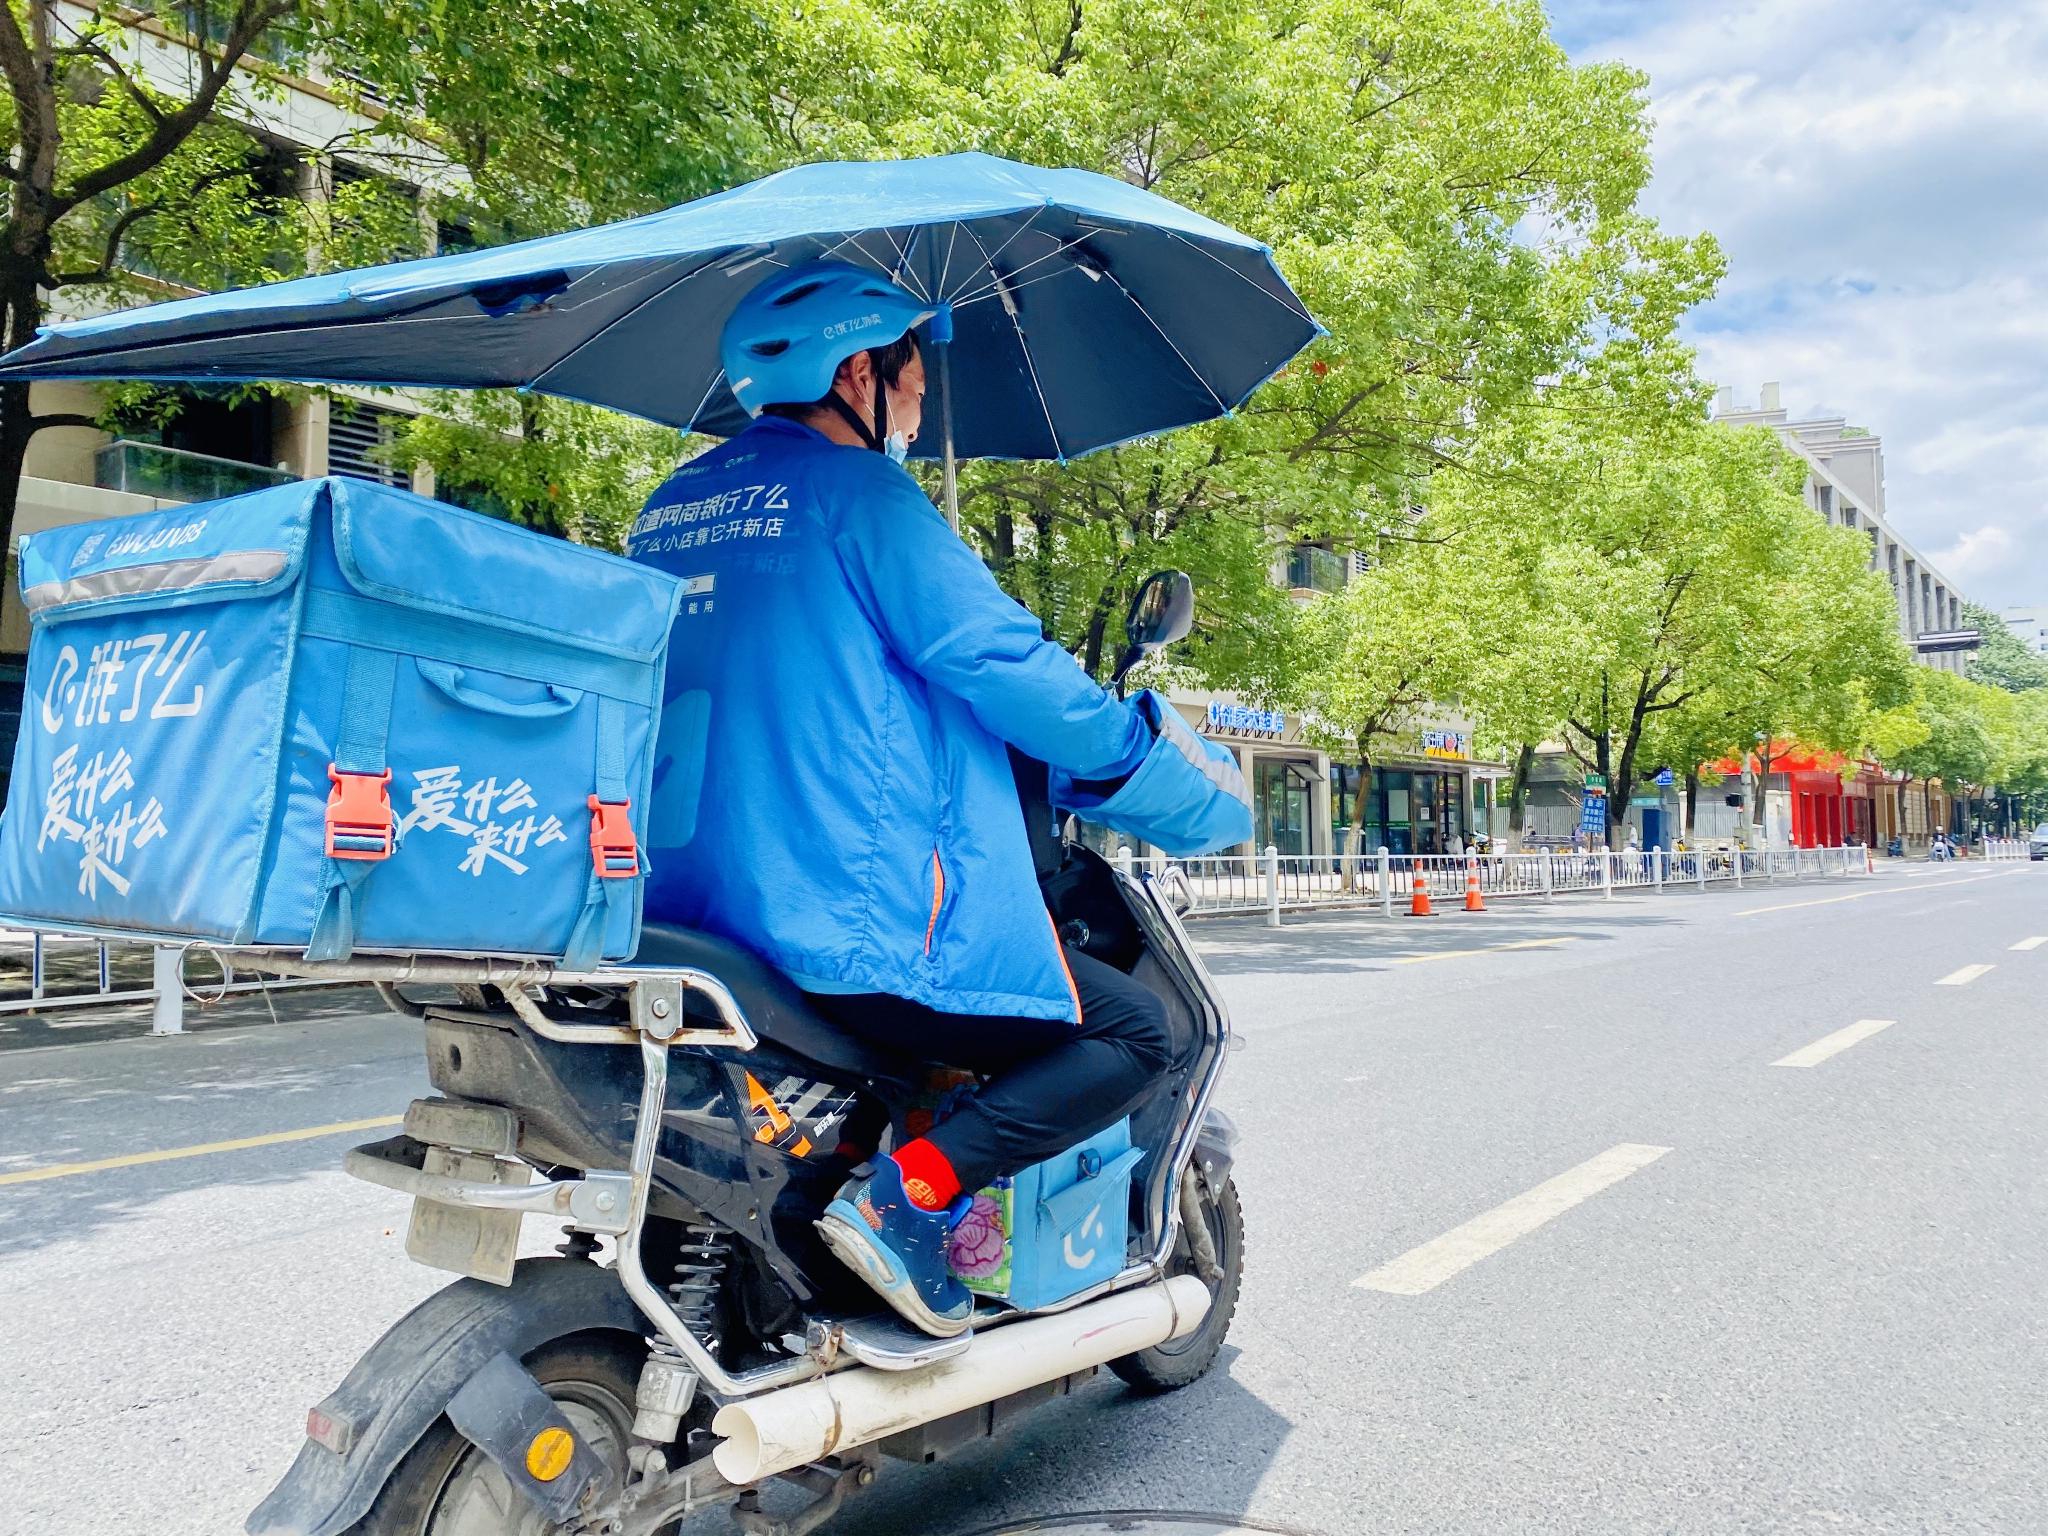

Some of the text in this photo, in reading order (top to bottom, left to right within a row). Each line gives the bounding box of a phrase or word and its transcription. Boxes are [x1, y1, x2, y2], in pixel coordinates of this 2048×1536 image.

[74, 629, 207, 728] 饿了么
[37, 743, 135, 854] 爱什么
[402, 765, 538, 837] 爱什么
[457, 814, 568, 878] 来什么
[78, 796, 168, 902] 来什么
